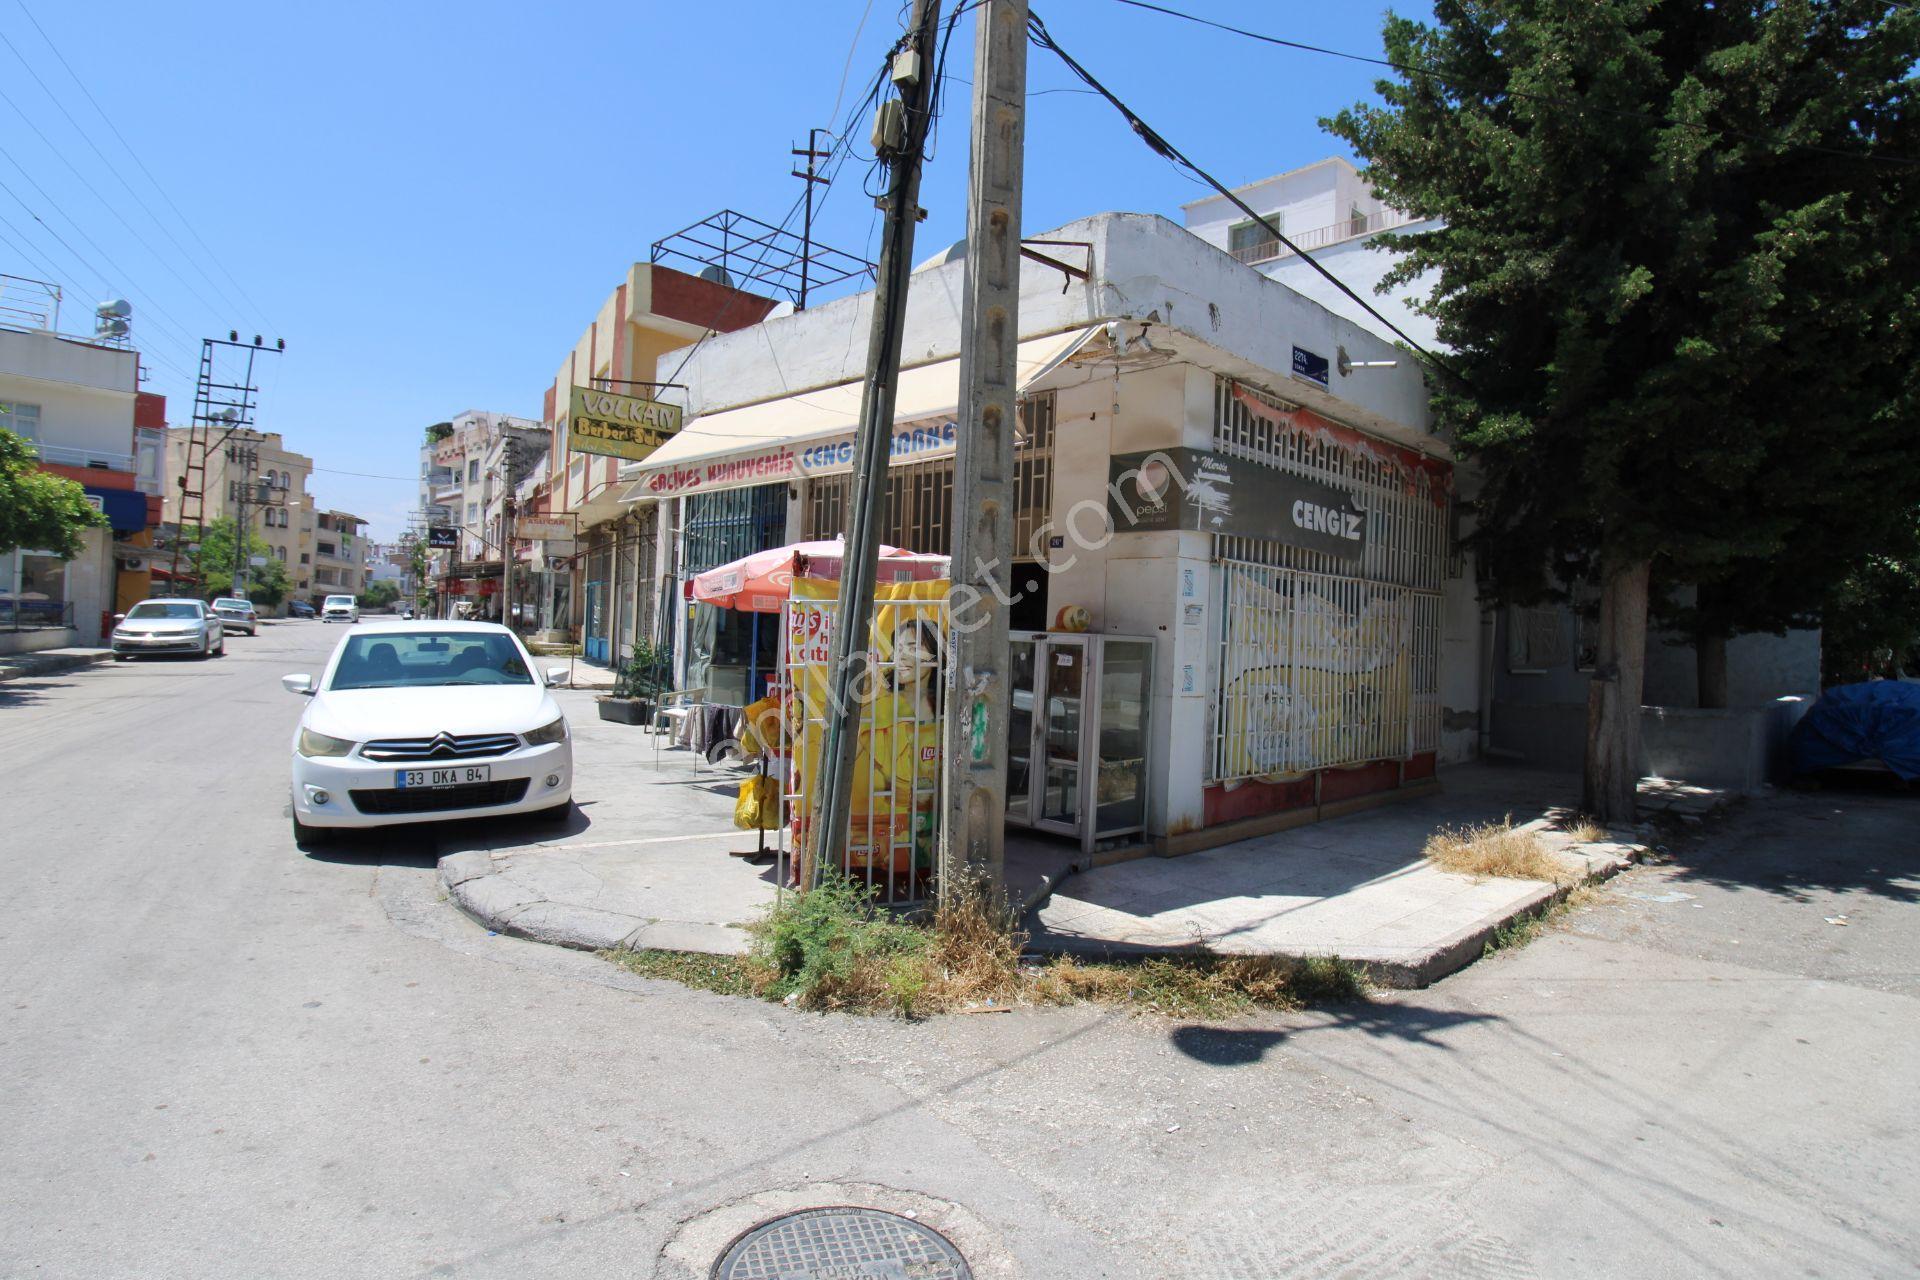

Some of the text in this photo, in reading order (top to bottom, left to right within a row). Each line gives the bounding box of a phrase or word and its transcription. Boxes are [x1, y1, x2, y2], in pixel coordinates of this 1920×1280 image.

[582, 392, 676, 430] VOLKAN
[1136, 502, 1168, 517] pepsi
[1292, 498, 1364, 541] CENGİZ
[407, 768, 482, 786] 33 DKA 84
